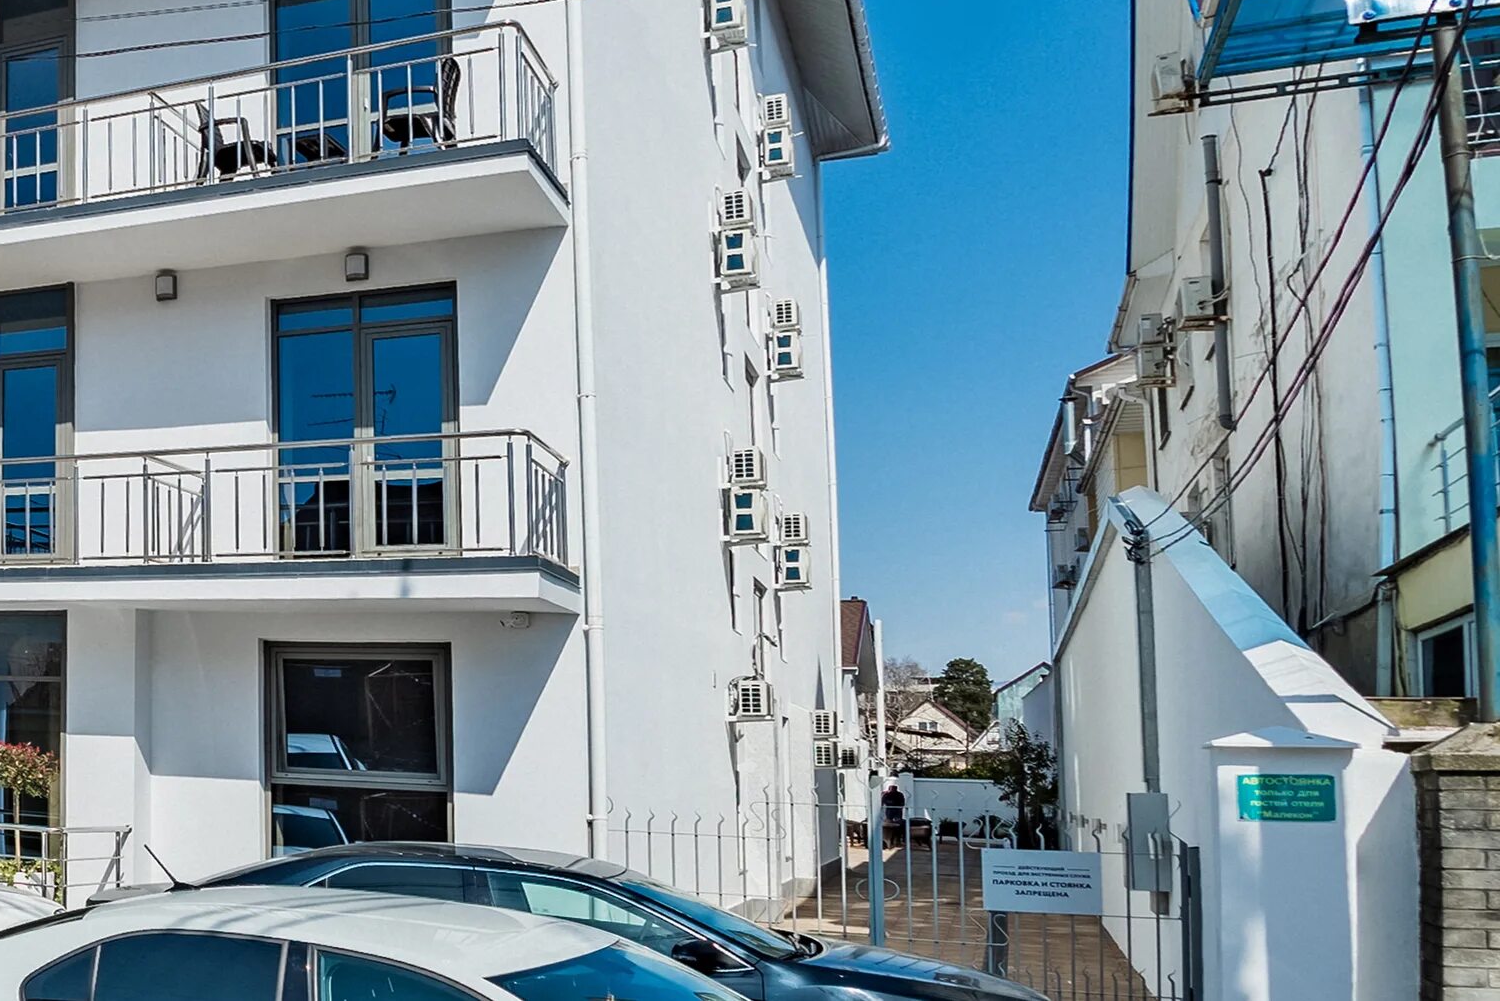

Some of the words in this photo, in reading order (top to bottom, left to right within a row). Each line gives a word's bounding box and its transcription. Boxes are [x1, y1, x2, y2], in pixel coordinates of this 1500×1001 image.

[1242, 776, 1332, 786] АВТОСТОЯНКА
[992, 879, 1039, 887] ПАРКОВКА
[1049, 881, 1092, 890] СТОЯНКА
[1015, 889, 1070, 898] ЗАПРЕЩЕНА
